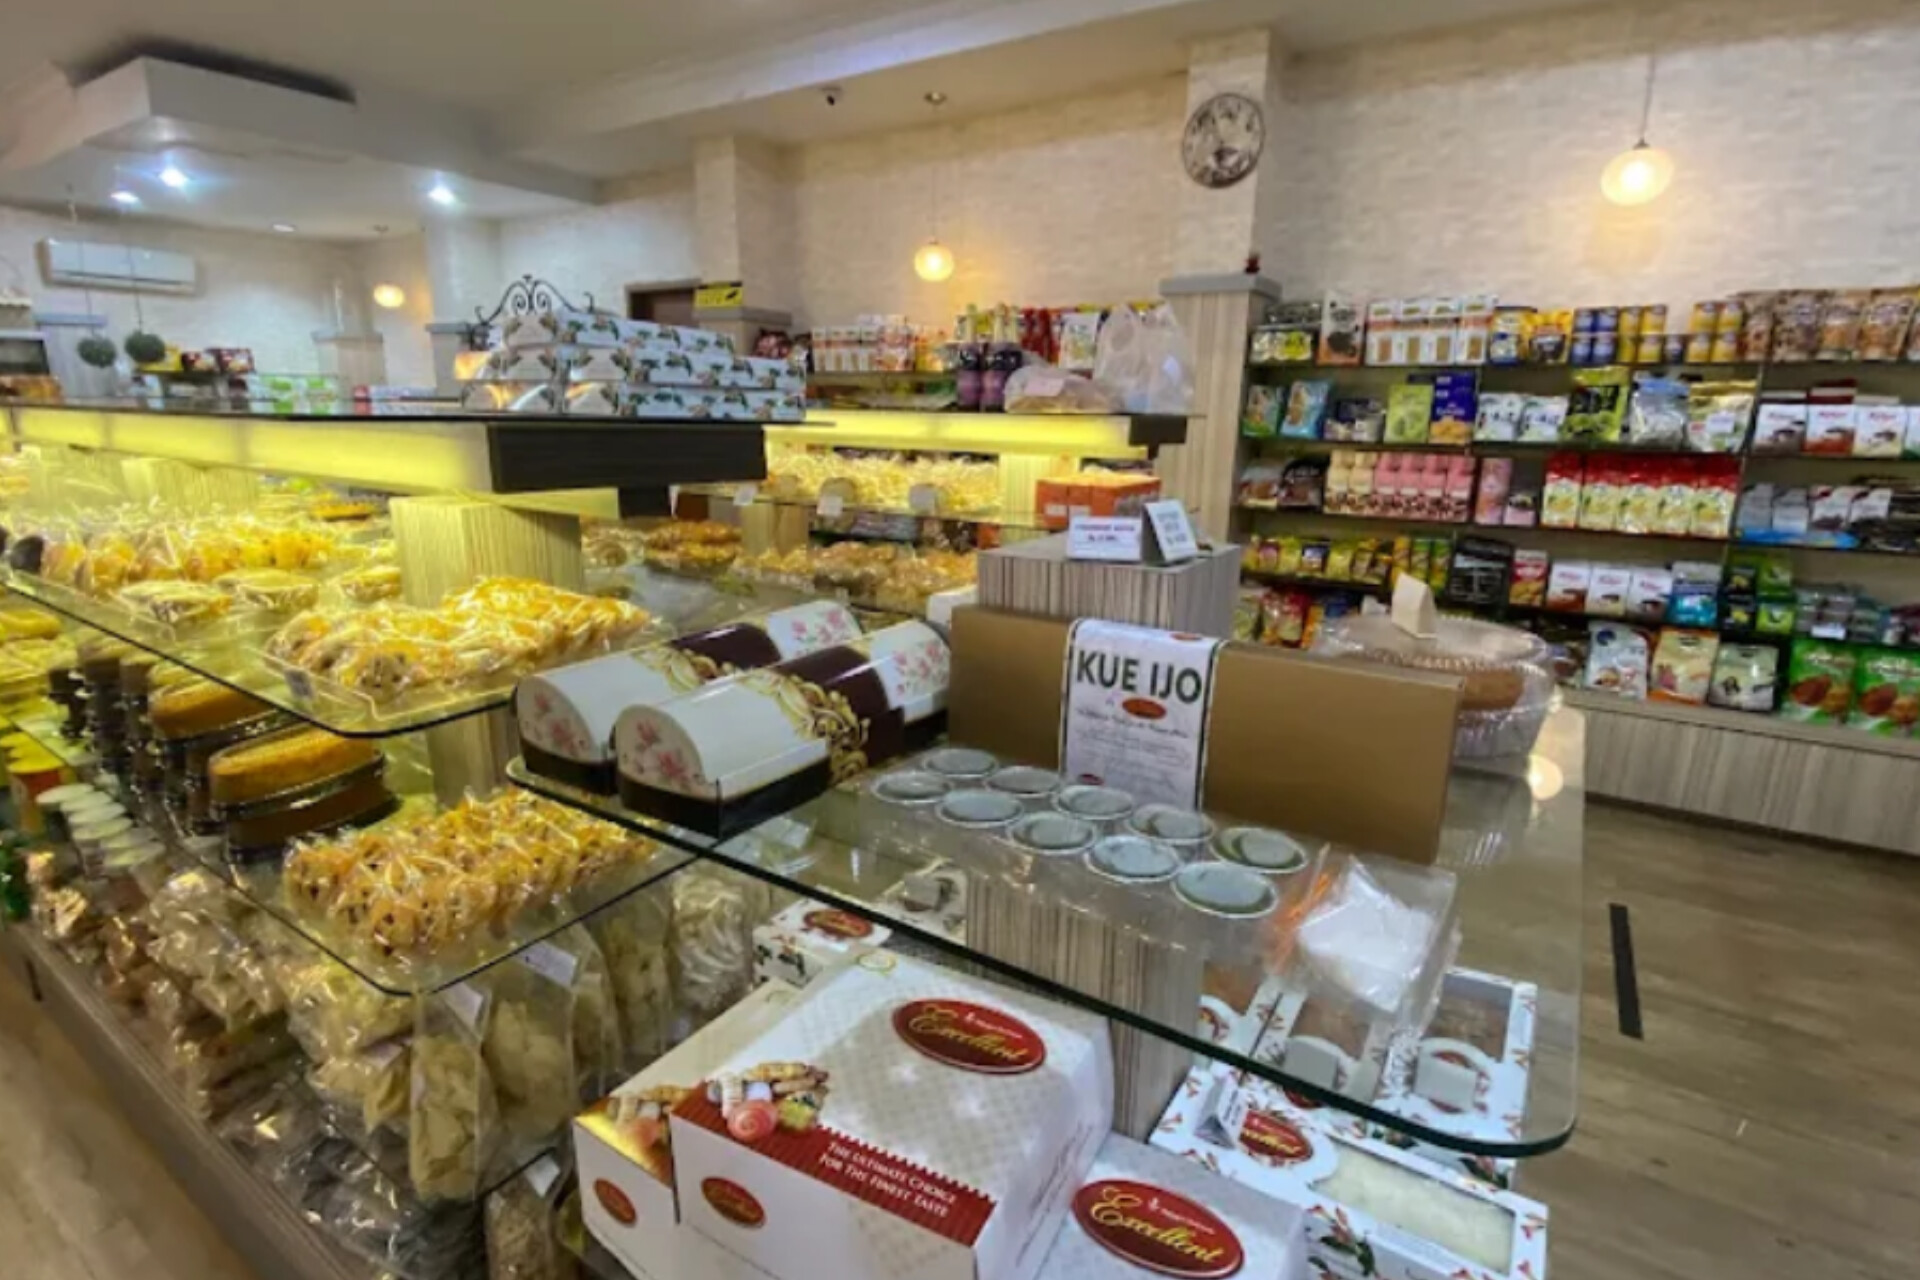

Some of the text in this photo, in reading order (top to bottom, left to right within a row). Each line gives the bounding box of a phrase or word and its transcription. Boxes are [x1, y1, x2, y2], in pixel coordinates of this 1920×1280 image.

[1077, 650, 1202, 704] KUE IJO
[908, 1003, 1029, 1061] Excellent
[819, 1152, 949, 1218] FOR THE FINEST TASTE
[852, 1152, 909, 1182] ULTIMATE
[908, 1176, 957, 1204] CHOICE
[1090, 1185, 1225, 1263] Excellent
